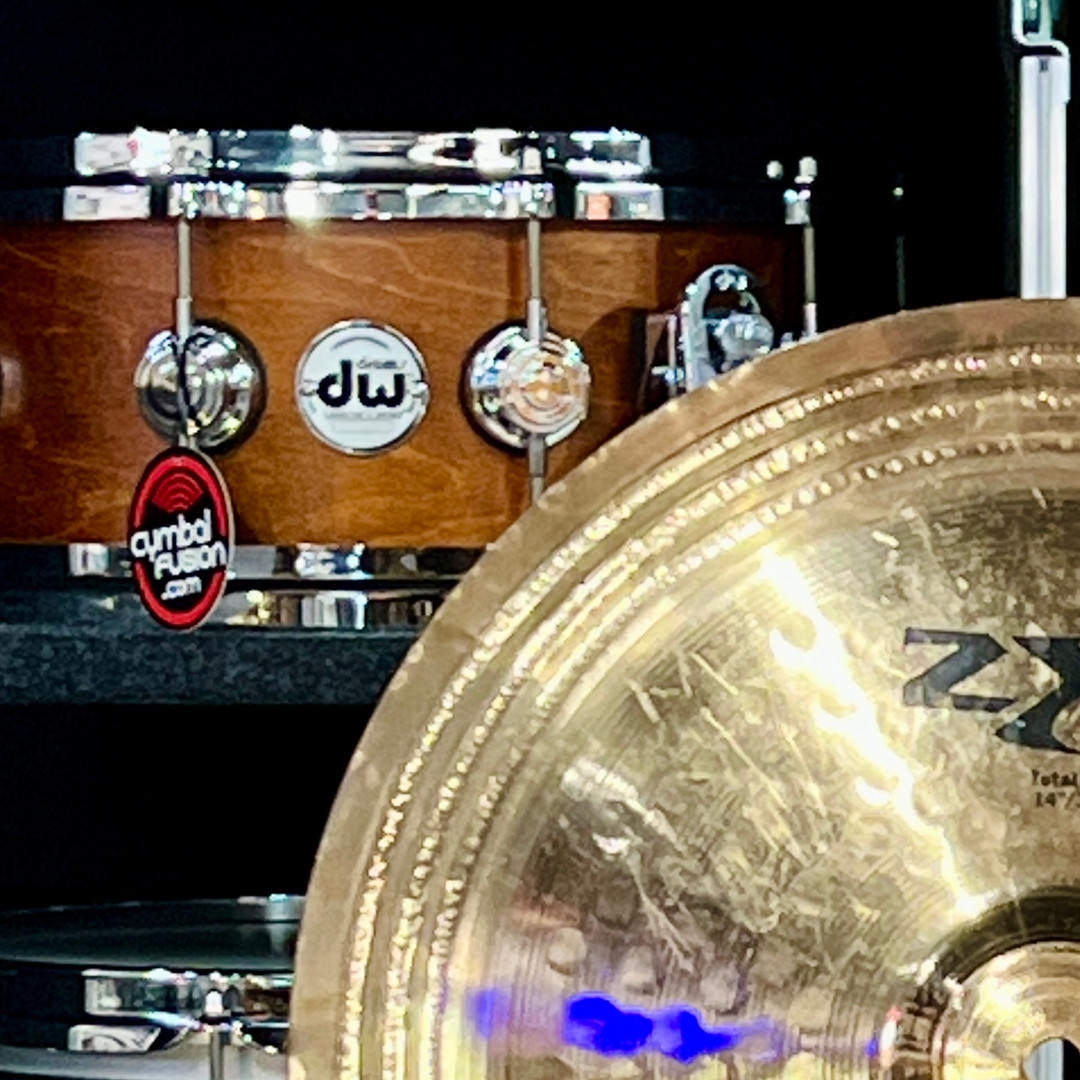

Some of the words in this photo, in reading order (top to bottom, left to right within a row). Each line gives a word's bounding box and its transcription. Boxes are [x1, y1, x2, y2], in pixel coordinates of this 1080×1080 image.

[316, 359, 406, 409] dw
[130, 507, 212, 563] cymbal
[1031, 769, 1079, 788] Total
